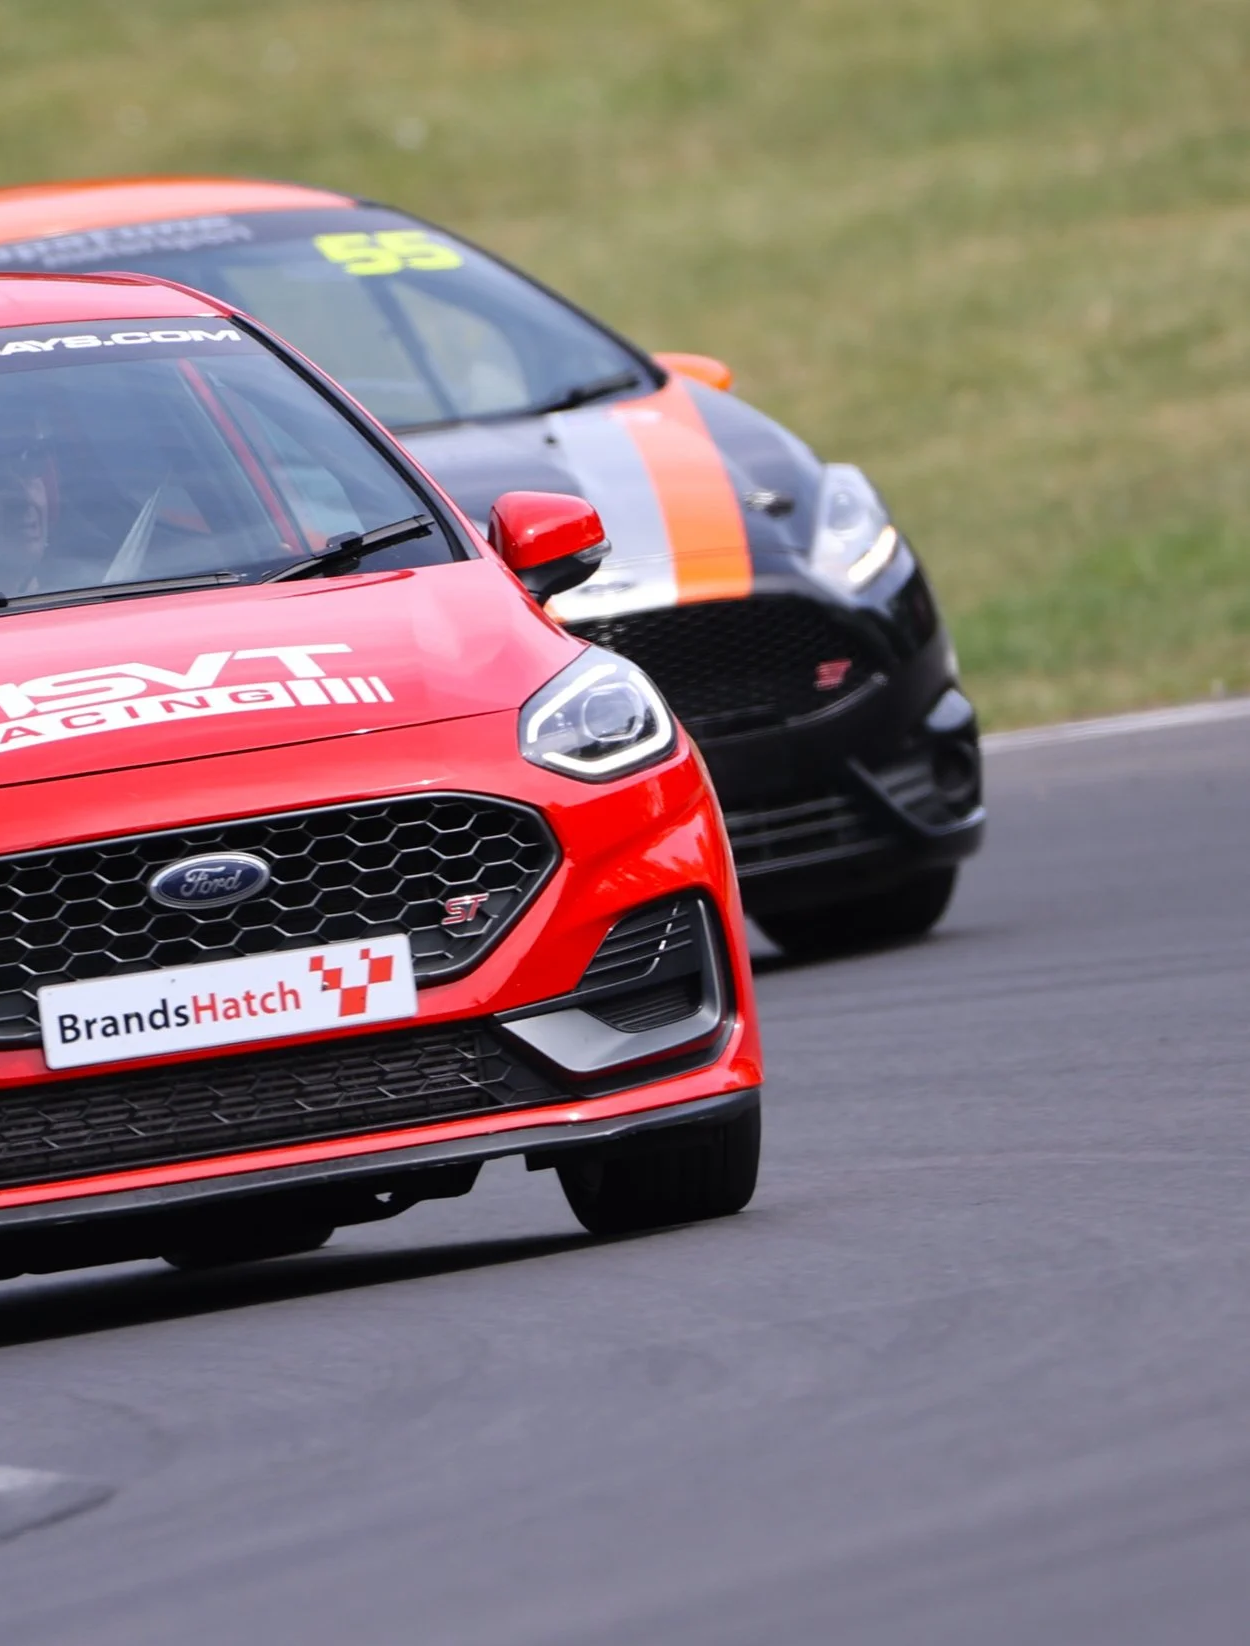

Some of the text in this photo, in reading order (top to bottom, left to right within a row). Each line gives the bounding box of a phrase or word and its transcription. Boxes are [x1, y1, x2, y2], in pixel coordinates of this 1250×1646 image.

[313, 230, 462, 276] 55
[180, 865, 243, 898] Ford
[441, 892, 490, 925] ST
[57, 980, 302, 1045] BrandsHatch
